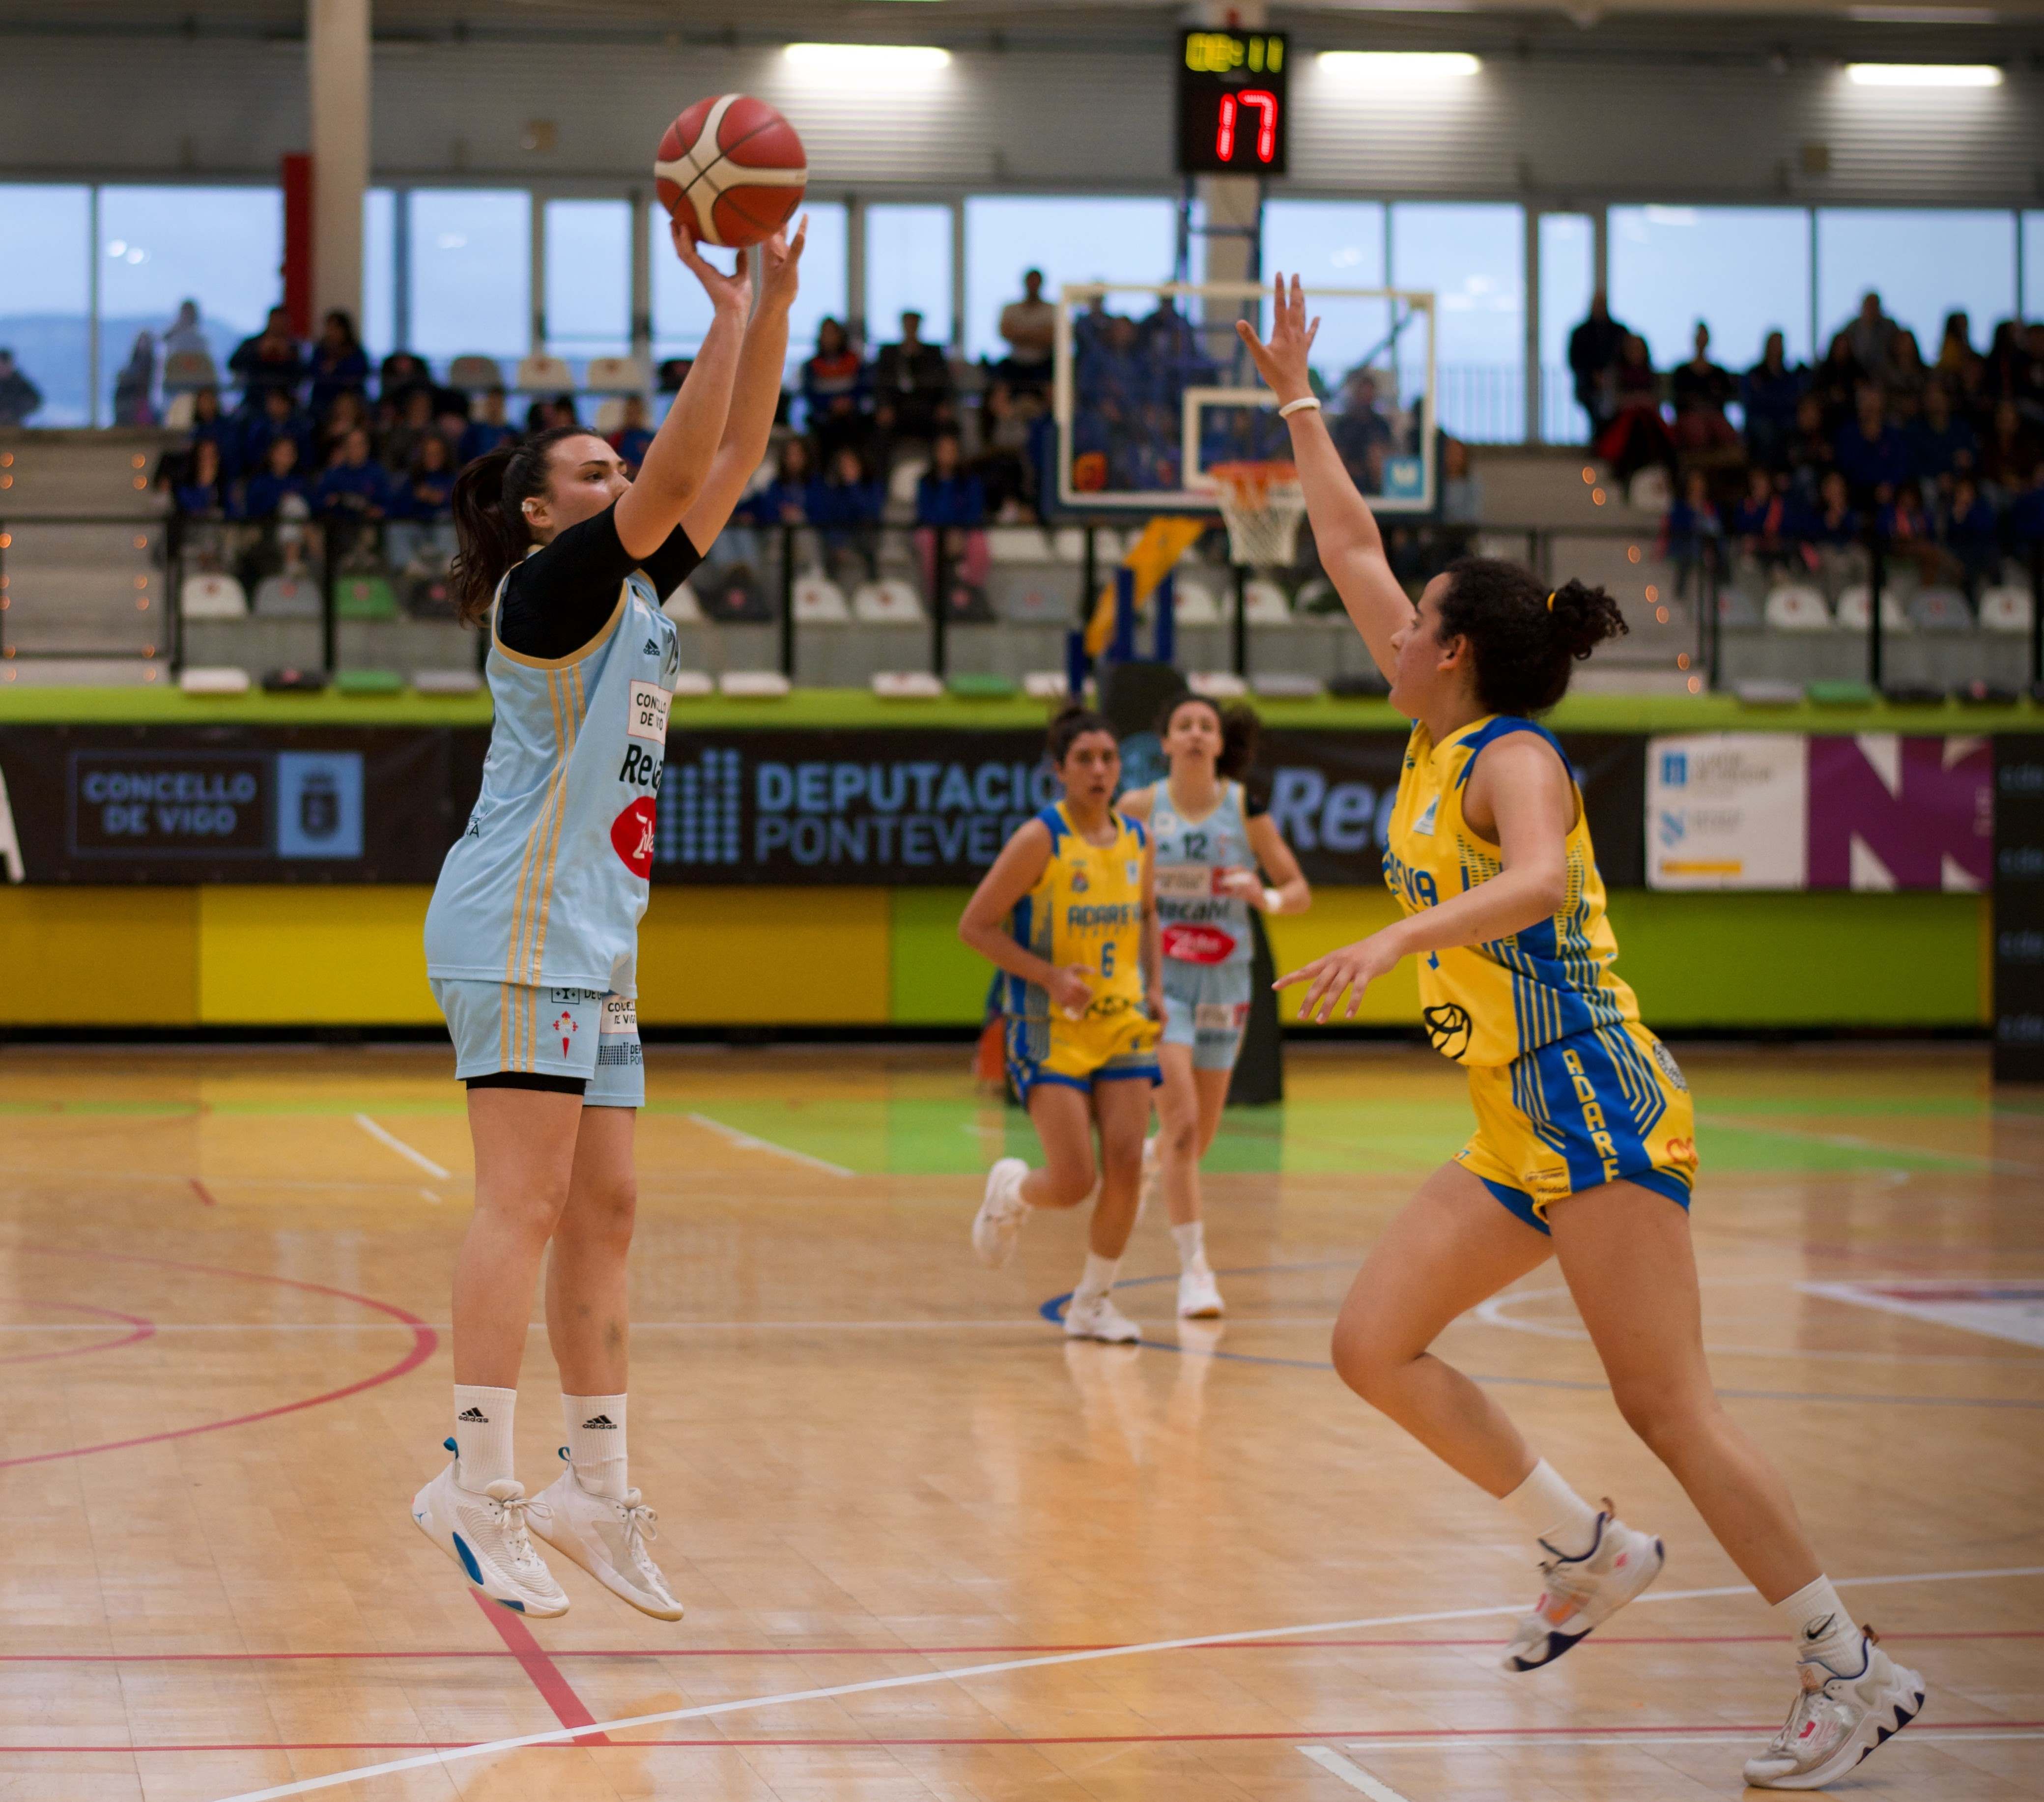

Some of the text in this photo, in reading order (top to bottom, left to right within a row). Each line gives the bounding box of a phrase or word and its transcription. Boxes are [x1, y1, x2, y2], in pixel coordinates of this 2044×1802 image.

[1216, 90, 1278, 163] 17
[640, 711, 654, 726] DE
[83, 772, 256, 804] CONCELLO
[104, 804, 237, 834] DE VIGO
[1182, 832, 1208, 859] 12
[1101, 940, 1116, 978] 6
